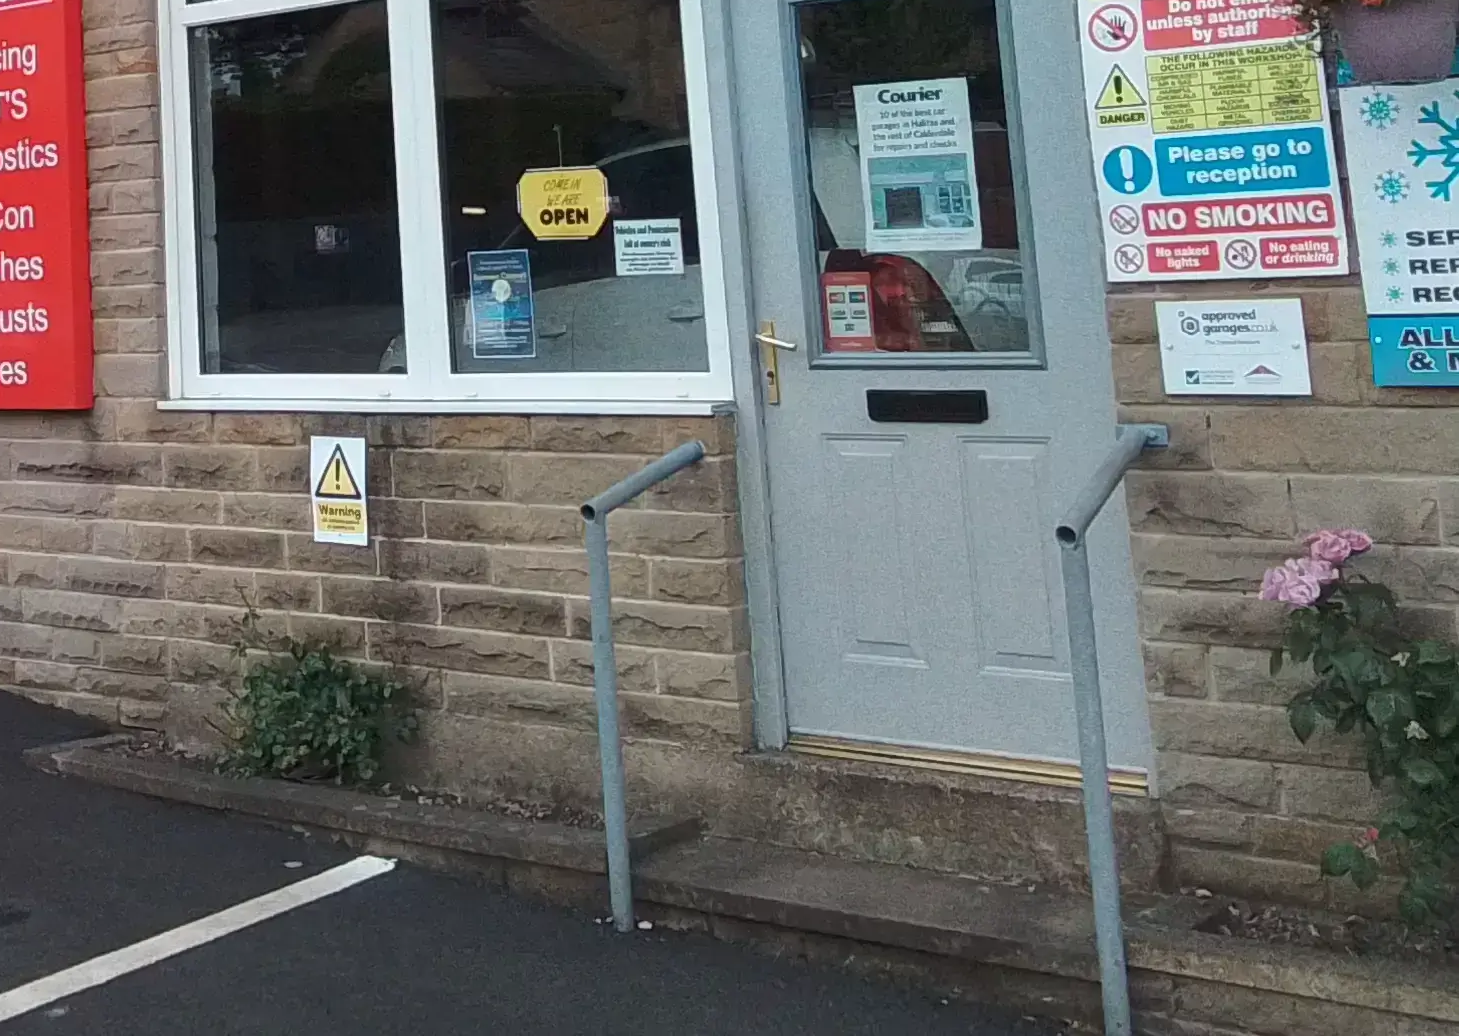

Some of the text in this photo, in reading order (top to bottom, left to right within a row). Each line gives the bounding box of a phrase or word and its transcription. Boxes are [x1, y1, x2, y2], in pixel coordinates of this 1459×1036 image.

[1168, 0, 1191, 13] Do
[1146, 15, 1203, 31] unless
[1192, 21, 1259, 44] by staff
[1160, 55, 1180, 63] THE
[1183, 48, 1244, 61] FOLLOWING
[1160, 63, 1196, 72] OCCUR
[1198, 61, 1210, 69] IN
[1212, 58, 1235, 67] THIS
[877, 86, 943, 104] Courier
[1099, 112, 1146, 125] DANGER
[1168, 139, 1312, 164] Please go to
[1186, 163, 1297, 185] reception
[543, 176, 581, 192] COME IN
[547, 193, 582, 206] WE ARE
[540, 207, 589, 226] OPEN
[1147, 200, 1329, 231] NO SMOKING
[1155, 245, 1209, 258] No naked
[1269, 241, 1329, 254] No eating
[1167, 255, 1200, 269] lights
[1265, 251, 1334, 264] or drinking
[1201, 309, 1256, 322] approved
[1397, 326, 1459, 349] ALL
[319, 504, 362, 520] Warning
